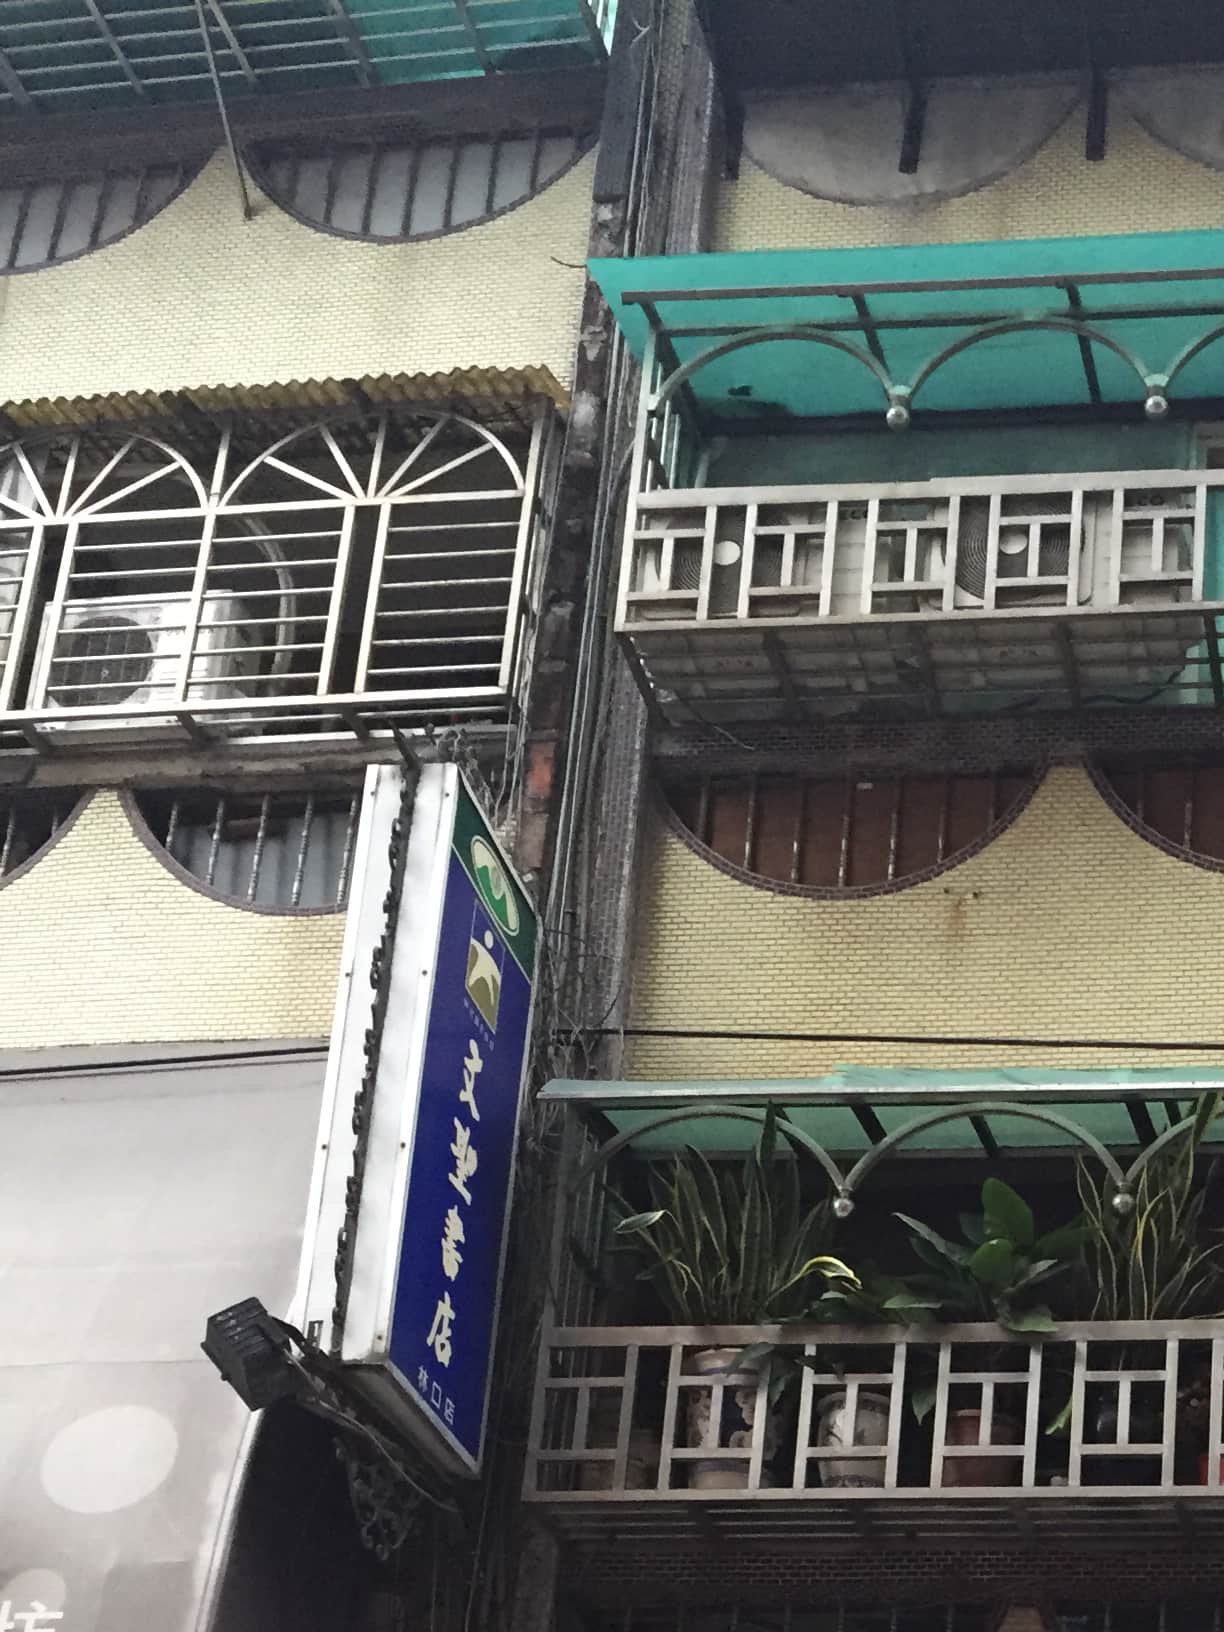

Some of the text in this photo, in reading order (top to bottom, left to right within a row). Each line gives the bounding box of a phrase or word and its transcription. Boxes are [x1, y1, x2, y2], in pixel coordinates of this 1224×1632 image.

[426, 1038, 484, 1367] 文聖書店
[418, 1365, 456, 1425] 林口店
